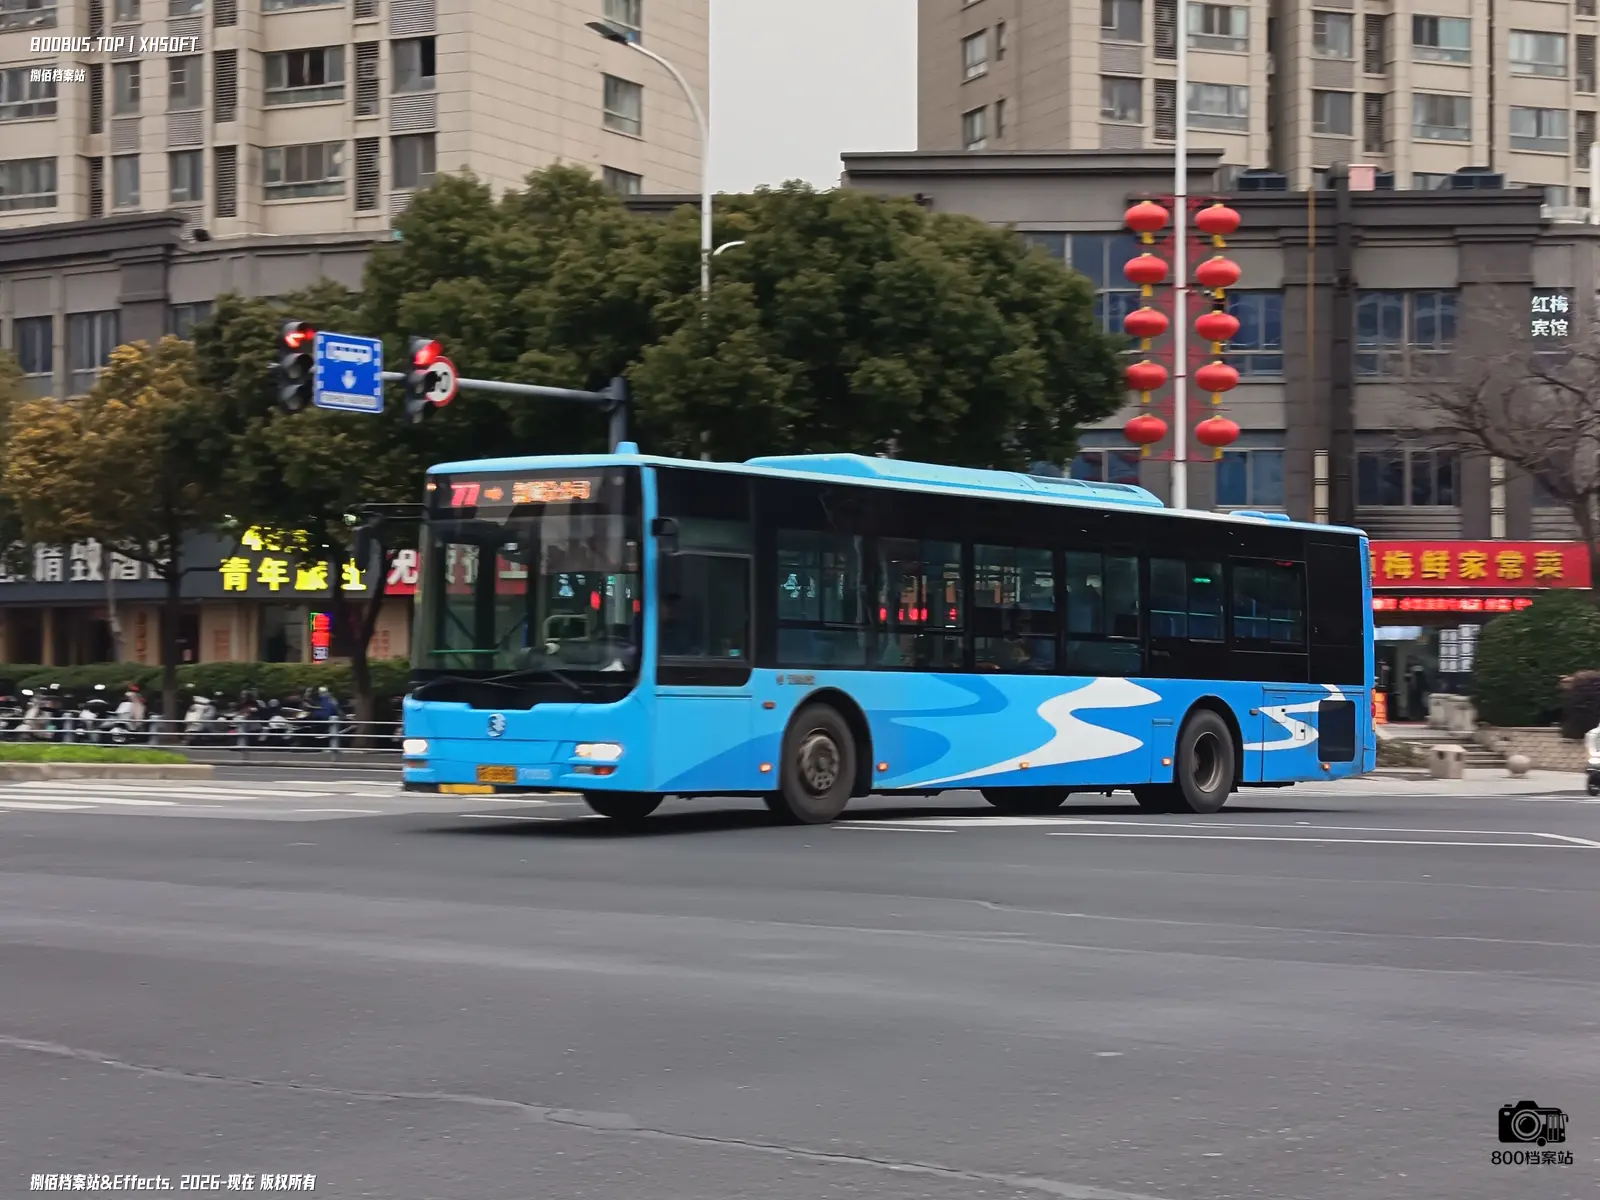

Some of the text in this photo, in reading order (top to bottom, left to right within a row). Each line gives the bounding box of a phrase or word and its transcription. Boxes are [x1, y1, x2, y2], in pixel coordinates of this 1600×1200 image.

[1531, 295, 1569, 313] 红梅
[1531, 319, 1569, 336] 宾馆
[451, 482, 480, 507] 77
